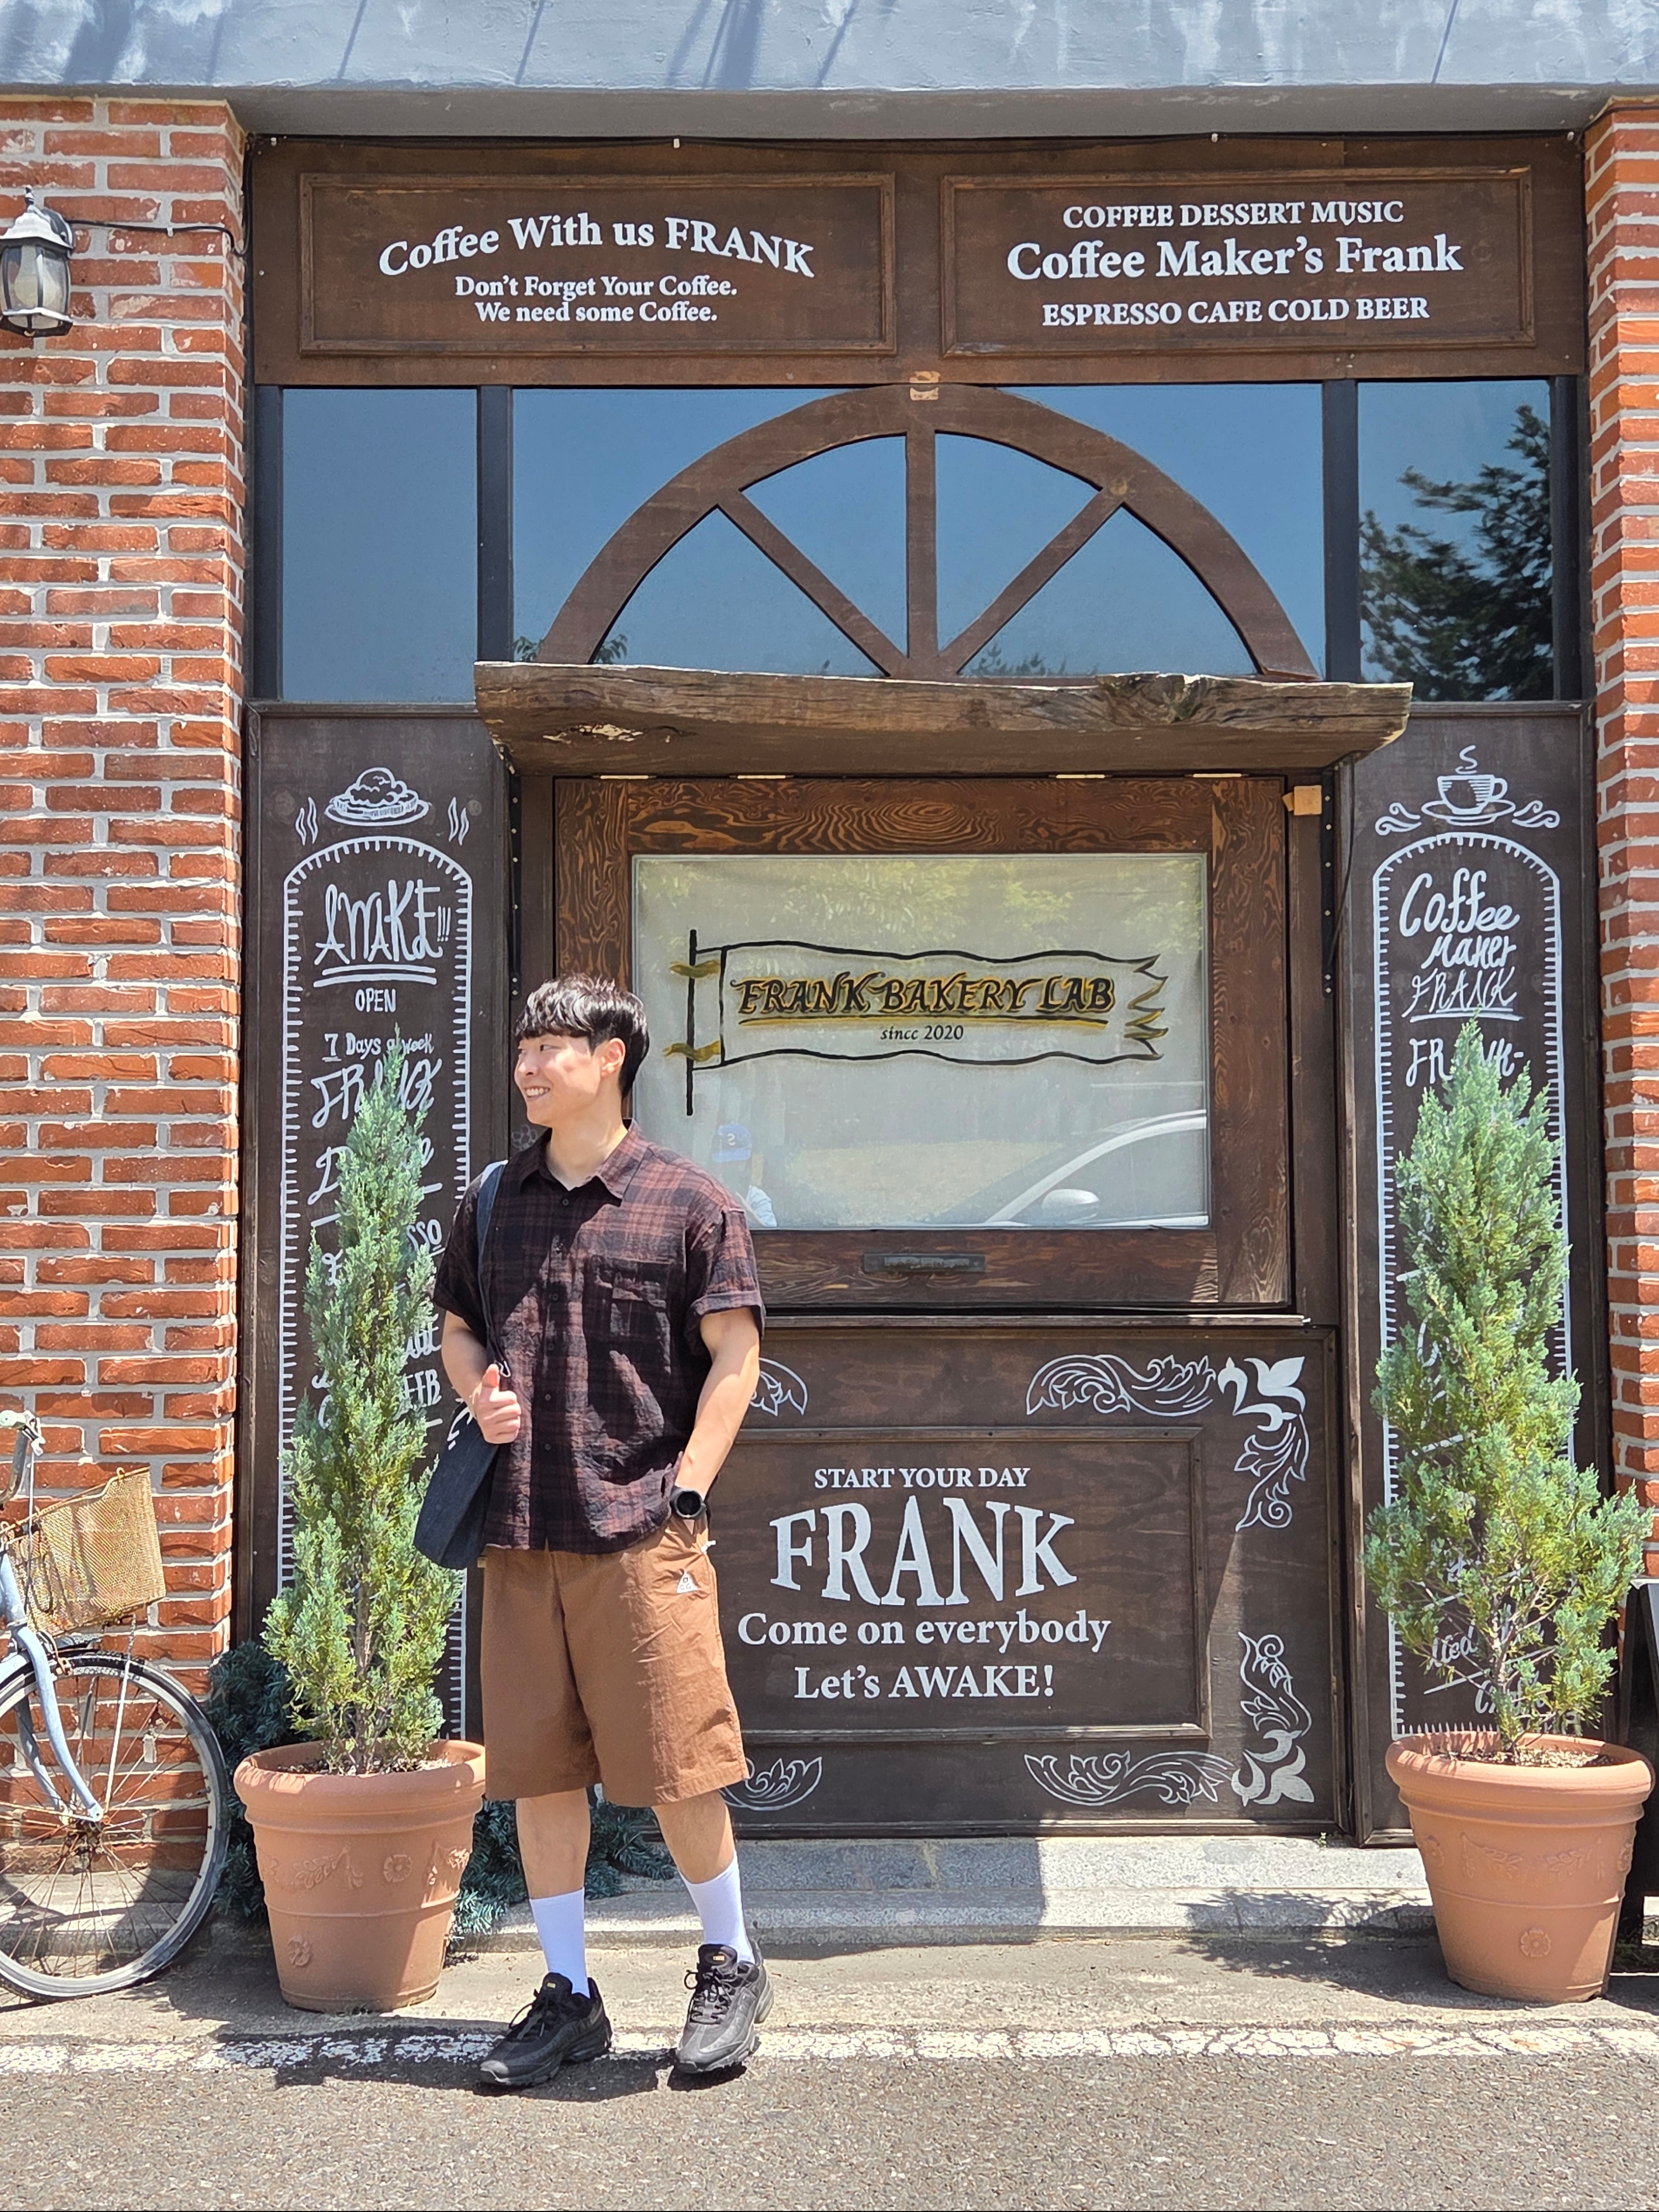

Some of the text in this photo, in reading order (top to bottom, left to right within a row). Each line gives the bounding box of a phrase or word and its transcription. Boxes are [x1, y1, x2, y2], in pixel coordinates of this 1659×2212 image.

[1063, 201, 1405, 228] COFFEE DESSERT MUSIC
[379, 212, 815, 278] Coffee With us FRANK
[1006, 233, 1464, 280] Coffee Maker's Frank
[455, 274, 738, 302] Don't Forget Your Coffee.
[474, 300, 718, 322] We need some Coffee.
[1042, 297, 1431, 326] ESPRESSO CAFE COLD BEER
[1399, 867, 1520, 937] Coffee
[354, 988, 397, 1013] OPEN
[729, 971, 1115, 1014] FRANK BAKERY LAB
[1401, 966, 1517, 1018] FRANK
[324, 1032, 339, 1057] 7
[345, 1032, 382, 1060] Days
[400, 1032, 435, 1055] week
[924, 1024, 964, 1041] 2020
[815, 1468, 1031, 1489] START YOUR DAY
[769, 1495, 1077, 1606] FRANK
[737, 1608, 1113, 1653] Come on everybody
[794, 1665, 1054, 1699] Let's AWAKE!
